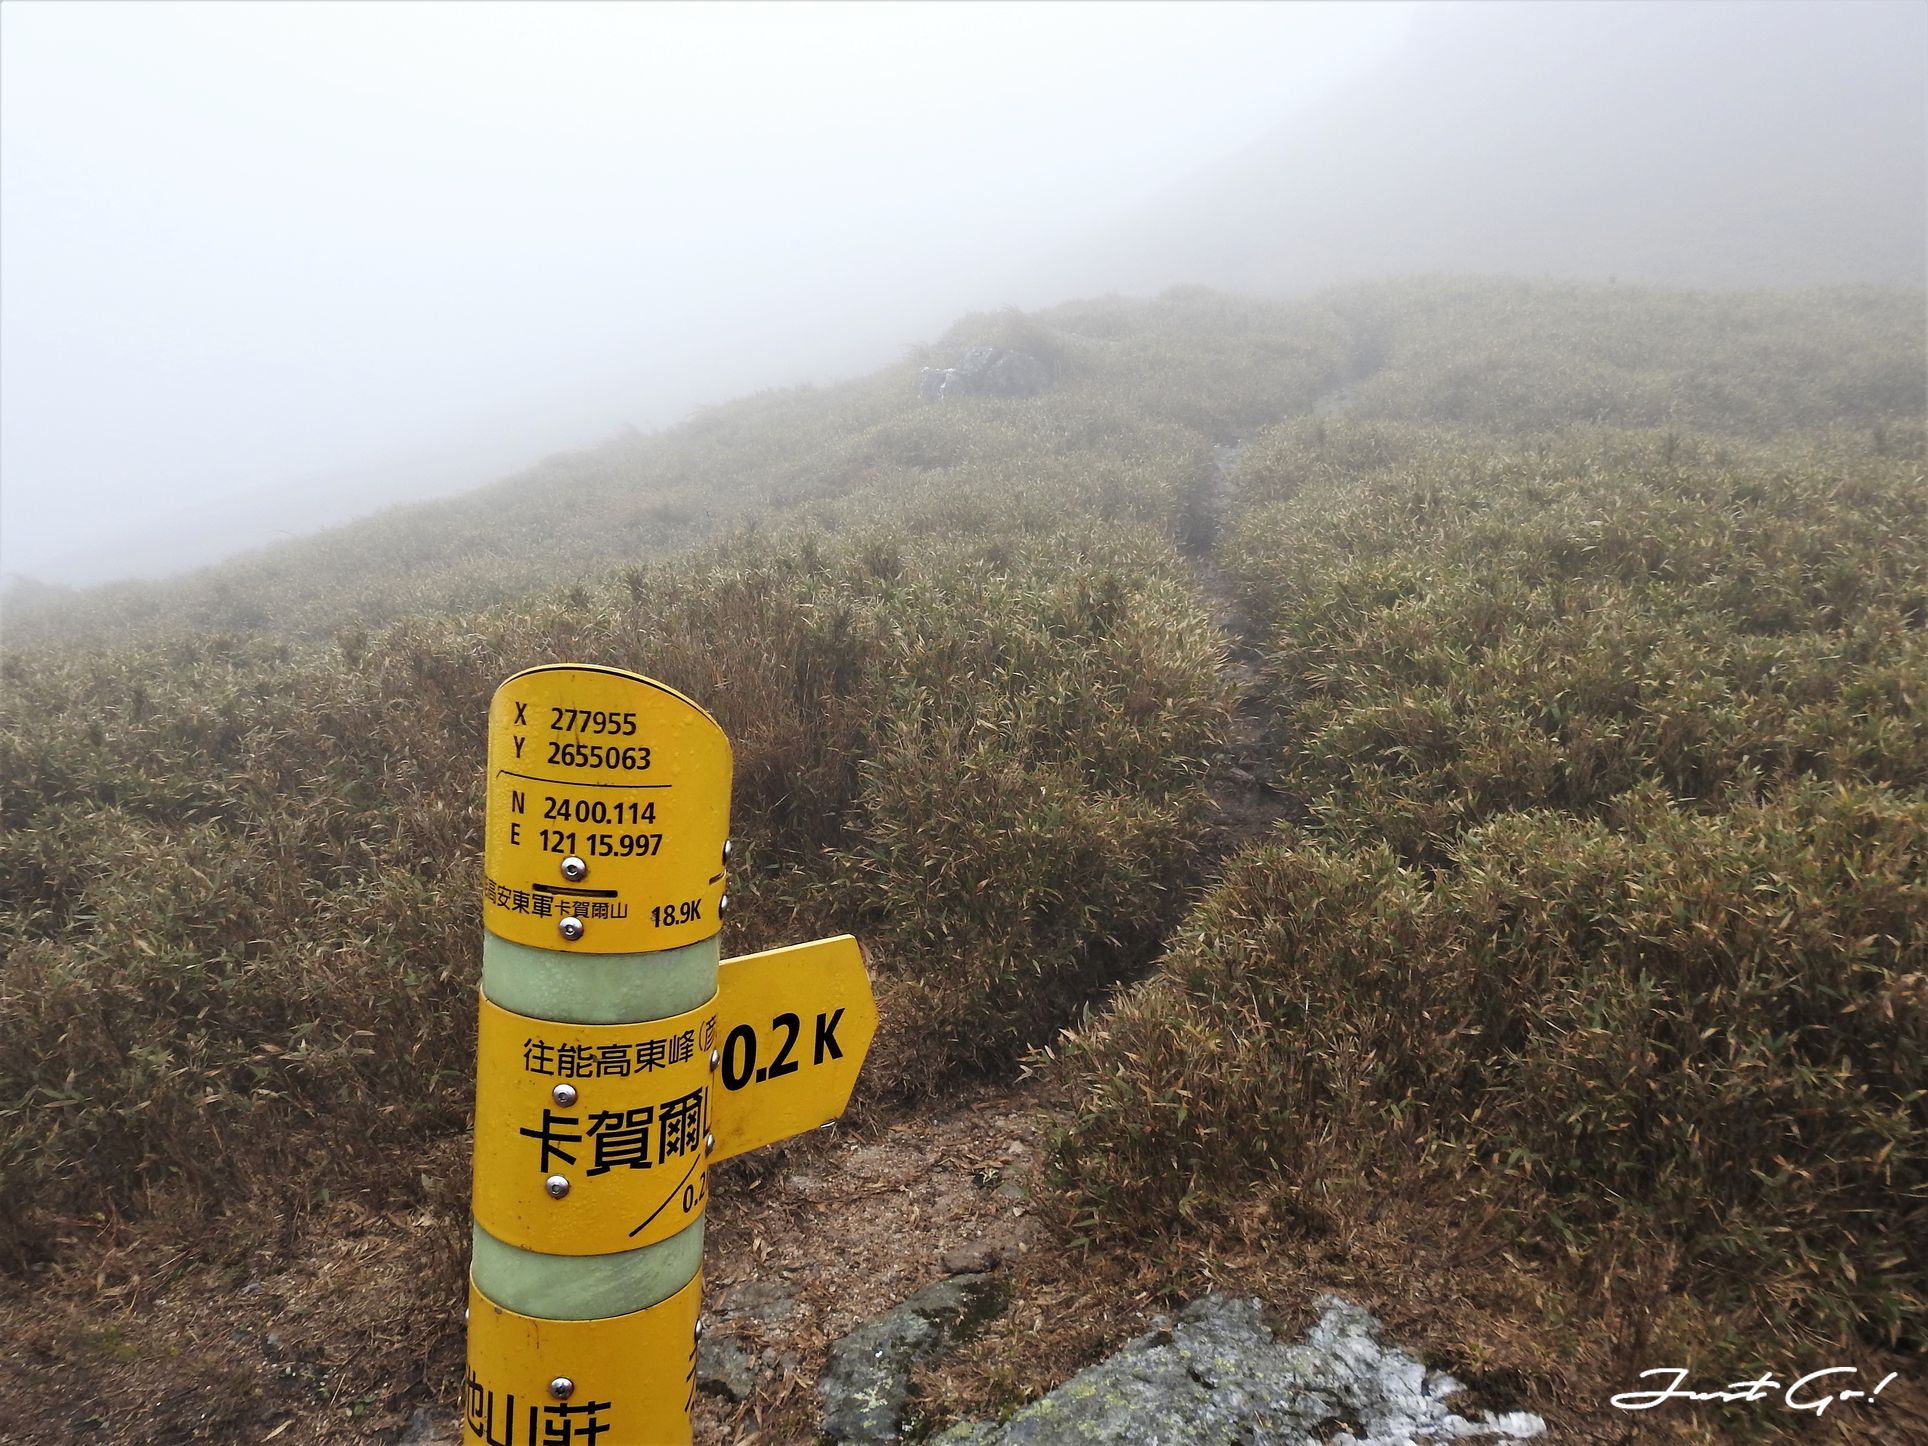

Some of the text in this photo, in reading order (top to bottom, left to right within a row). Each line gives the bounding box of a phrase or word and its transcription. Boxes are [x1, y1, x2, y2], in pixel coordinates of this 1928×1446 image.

[514, 701, 637, 736] X 277955
[513, 735, 651, 770] Y 2655063
[511, 790, 525, 815] N
[510, 822, 521, 846] E
[651, 898, 702, 928] 18.9K
[721, 1007, 846, 1091] 0.2 K
